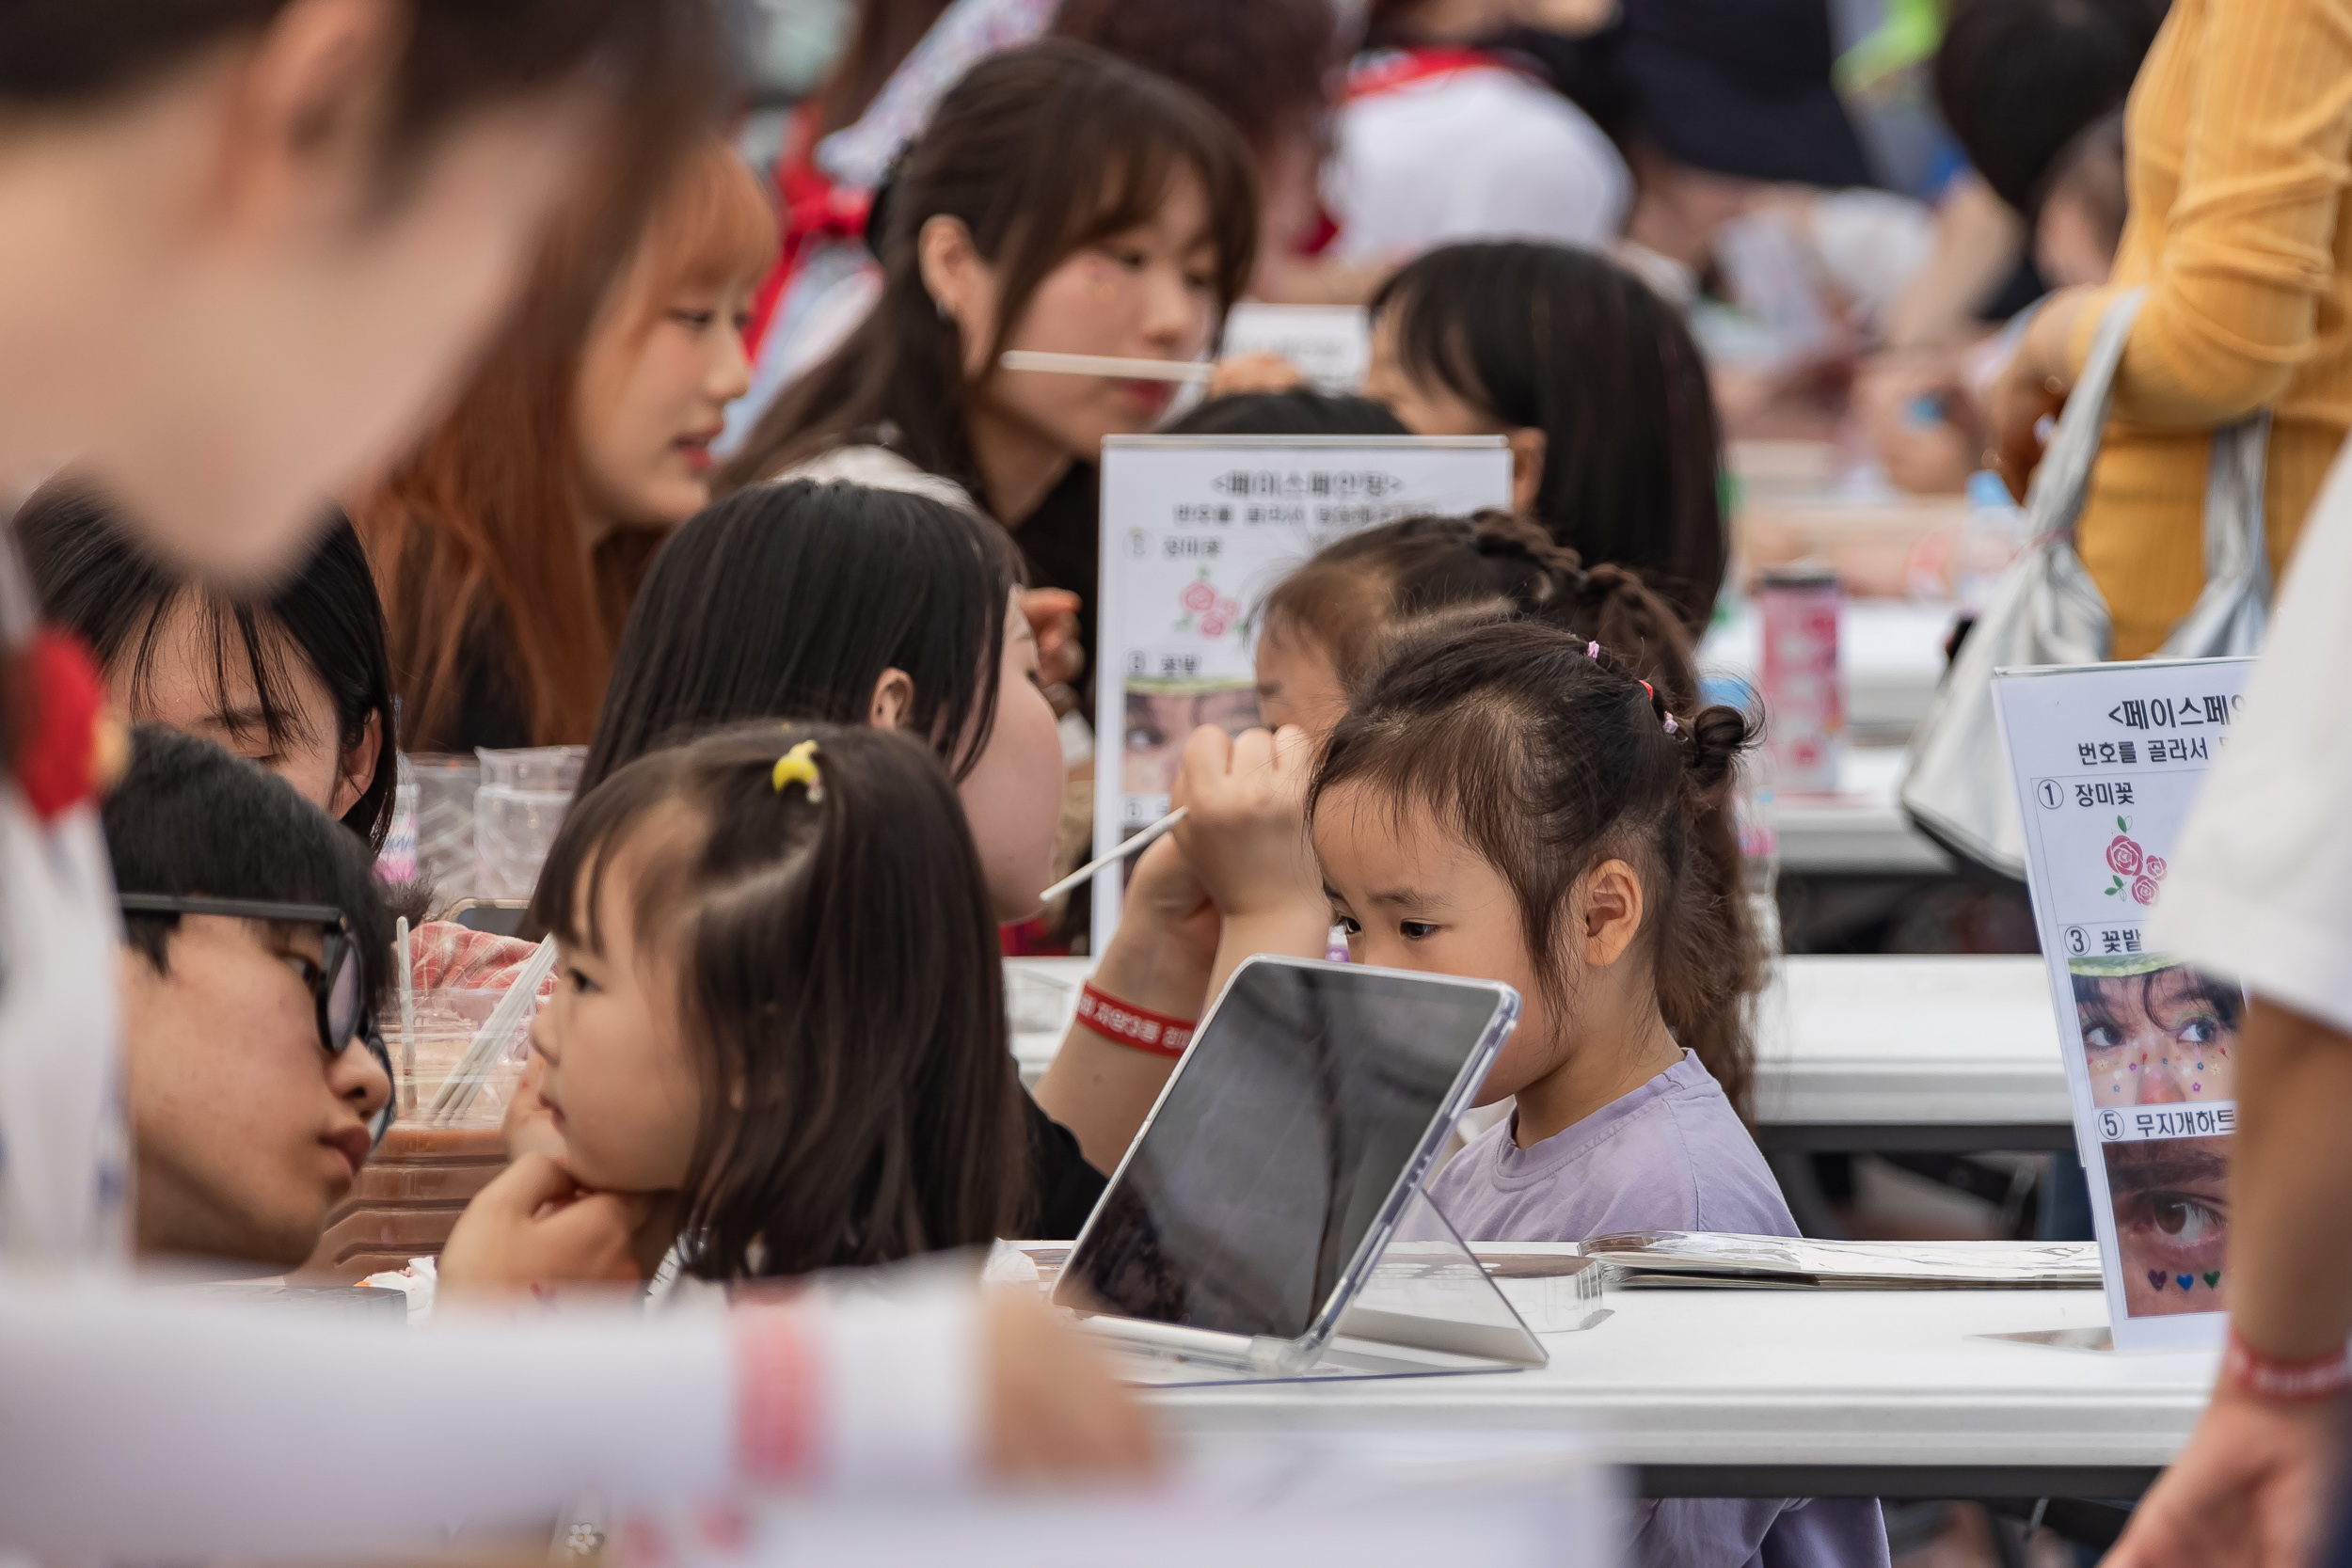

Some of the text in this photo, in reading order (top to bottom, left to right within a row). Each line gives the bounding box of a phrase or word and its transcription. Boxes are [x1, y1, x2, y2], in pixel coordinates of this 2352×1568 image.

[2078, 741, 2137, 766] 번호를
[2148, 736, 2208, 762] 골라서
[2074, 782, 2135, 807] 장미꽃
[2101, 929, 2142, 954] 꽃밭
[2136, 1109, 2236, 1137] 무지개하트
